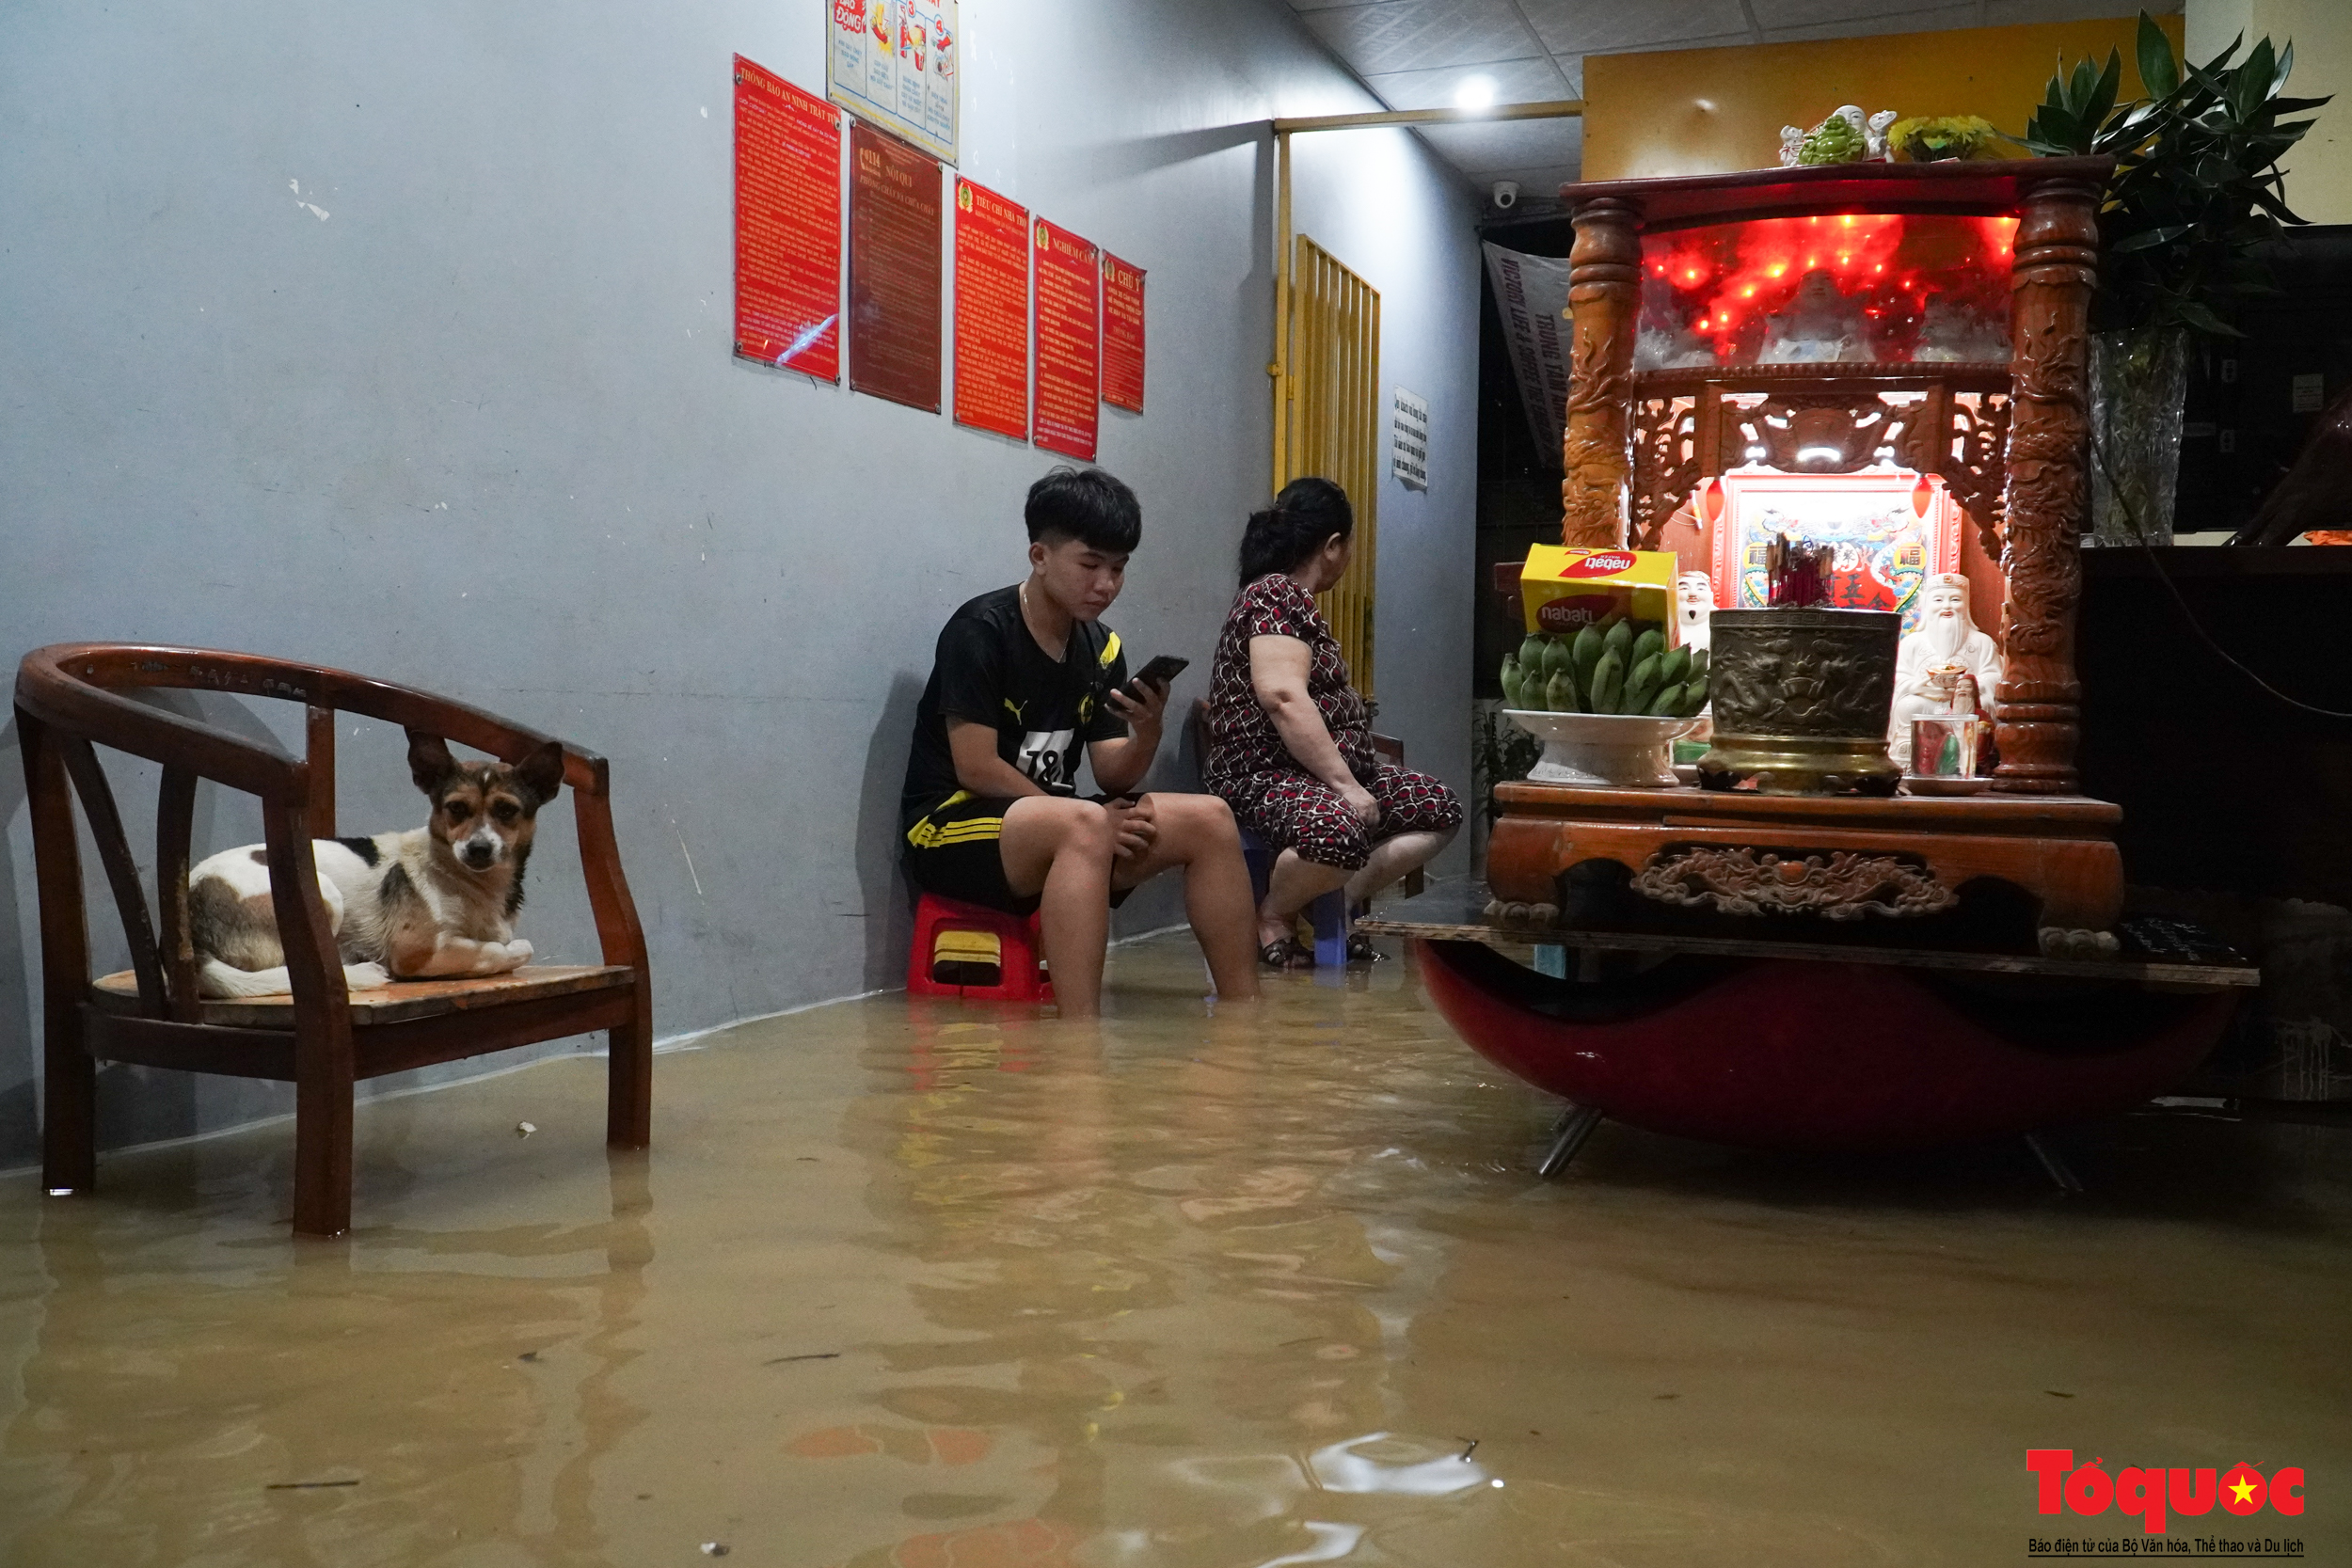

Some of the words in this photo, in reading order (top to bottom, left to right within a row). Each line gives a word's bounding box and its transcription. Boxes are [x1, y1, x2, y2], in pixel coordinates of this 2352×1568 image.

[782, 90, 791, 102] AN
[792, 94, 808, 112] NINH
[869, 150, 881, 168] 114
[899, 172, 912, 188] QUI
[1119, 270, 1134, 289] CHÚ
[1511, 307, 1531, 333] LIFE
[1535, 314, 1561, 359] TRUNG
[1584, 556, 1631, 571] nabati
[1900, 546, 1921, 565] 福
[1541, 605, 1593, 624] nabati
